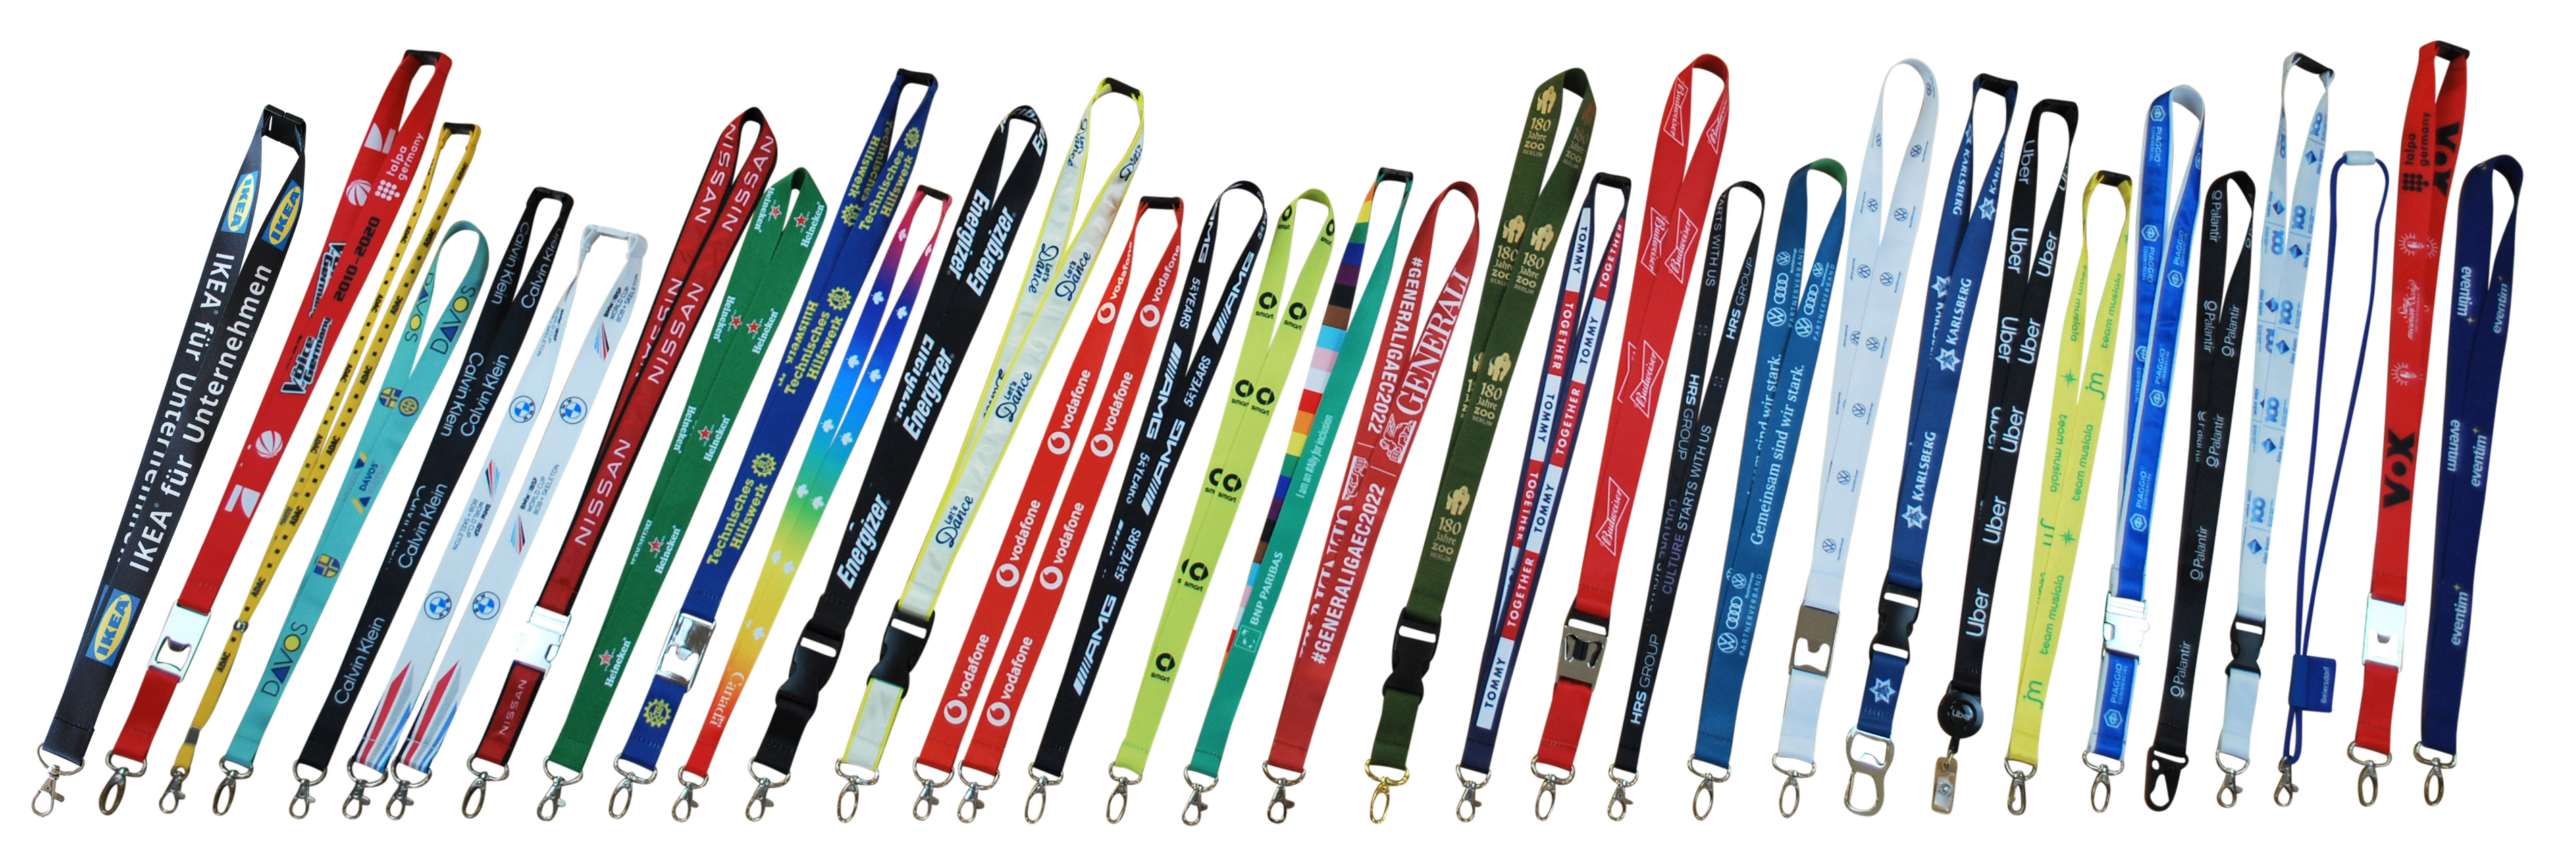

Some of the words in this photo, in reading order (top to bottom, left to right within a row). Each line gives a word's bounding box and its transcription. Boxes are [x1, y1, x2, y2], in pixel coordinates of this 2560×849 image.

[1530, 117, 1552, 132] 180
[2154, 126, 2163, 162] PIAGGIO
[2403, 133, 2416, 165] talpa
[2420, 112, 2432, 166] germany
[387, 145, 407, 176] talpa
[398, 132, 424, 181] germany
[1953, 148, 1970, 215] KARLSBERG
[2018, 140, 2035, 184] Uber
[229, 178, 252, 229] IKEA
[722, 136, 773, 232] NISSAN
[859, 150, 904, 230] Technisches
[880, 155, 913, 217] Hilfswerk
[271, 190, 300, 241] IKEA
[801, 202, 825, 248] Heineken
[949, 189, 990, 280] Energizer
[2209, 202, 2221, 242] Palantir
[333, 216, 380, 302] 2010-2020
[966, 207, 1015, 296] Energizer
[1110, 241, 1133, 299] vodafone
[1522, 252, 1545, 270] 180
[1572, 225, 1588, 274] TOMMY
[1599, 223, 1623, 289] TOGETHER
[1670, 219, 1691, 274] Budweiser
[1709, 234, 1721, 266] WITH
[2008, 227, 2029, 274] Uber
[2035, 231, 2058, 278] Uber
[2146, 247, 2155, 283] PIAGGIO
[200, 253, 235, 308] IKEA
[1055, 251, 1091, 301] Dance
[1152, 245, 1180, 302] vodafone
[1705, 270, 1717, 287] US
[1726, 308, 1741, 340] HRS
[1735, 257, 1753, 306] GROUP
[2458, 266, 2473, 317] eventim
[1255, 310, 1275, 320] smart
[1284, 319, 1303, 331] smart
[1813, 264, 1835, 341] PARTNERVERBAND
[1945, 278, 1972, 345] KARLSBERG
[2224, 305, 2240, 346] Palantir
[2493, 283, 2507, 334] eventim
[186, 321, 215, 361] für
[304, 317, 332, 384] Germany
[648, 282, 703, 384] NISSAN
[752, 308, 778, 354] Heineken
[784, 311, 830, 395] Technisches
[807, 316, 843, 380] Hilfswerk
[1368, 256, 1423, 435] #GENERALIGAEC2022
[1396, 267, 1470, 416] GENERALI
[1553, 303, 1573, 370] TOGETHER
[1579, 317, 1598, 365] TOMMY
[1998, 316, 2019, 363] Uber
[2203, 313, 2217, 353] Palantir
[161, 455, 192, 497] für
[182, 265, 272, 443] Unternehmen
[456, 352, 484, 399] Calvin
[1004, 381, 1017, 400] Let's
[1480, 381, 1503, 401] 180
[1636, 351, 1657, 409] Budweiser
[1685, 373, 1700, 405] HRS
[1767, 354, 1781, 391] stark.
[1787, 365, 1804, 402] stark.
[2155, 348, 2166, 385] PIAGGIO
[441, 400, 465, 437] Klein
[460, 390, 493, 437] Calvin
[482, 354, 509, 391] Klein
[902, 347, 953, 441] Energizer
[995, 371, 1032, 423] Dance
[1061, 369, 1091, 430] vodafone
[1104, 371, 1133, 432] vodafone
[1251, 403, 1270, 416] smart
[1538, 393, 1555, 442] TOMMY
[1761, 394, 1774, 418] wir
[1781, 404, 1794, 427] wir
[704, 414, 730, 462] Heineken
[1556, 387, 1581, 455] TOGETHER
[1678, 408, 1694, 460] GROUP
[1771, 430, 1788, 460] sind
[2057, 414, 2068, 444] team
[2209, 414, 2224, 455] Palantir
[2447, 419, 2460, 472] eventim
[359, 460, 379, 491] DAVOS
[1912, 431, 1936, 502] KARLSBERG
[2050, 448, 2062, 492] musiala
[2071, 470, 2085, 501] team
[2079, 424, 2093, 468] musiala
[2383, 428, 2415, 508] VOX
[2471, 435, 2487, 487] eventim
[575, 439, 631, 546] NISSAN
[730, 482, 768, 550] Hilfswerk
[944, 505, 958, 525] Let's
[1517, 473, 1538, 541] TOGETHER
[1534, 483, 1555, 533] TOMMY
[1600, 488, 1623, 547] Budweiser
[1662, 533, 1685, 594] CULTURE
[1677, 480, 1697, 531] STARTS
[1690, 444, 1706, 478] WITH
[1700, 425, 1711, 442] US
[1751, 462, 1780, 545] Gemeinsam
[398, 520, 430, 569] Calvin
[420, 483, 448, 520] Klein
[707, 478, 755, 565] Technisches
[837, 493, 889, 590] Energizer
[935, 495, 973, 548] Dance
[1438, 516, 1462, 535] 180
[654, 525, 681, 574] Heineken
[1311, 483, 1385, 665] #GENERALIGAEC2022
[1250, 601, 1263, 626] BNP
[1258, 550, 1283, 600] PARIBAS
[2044, 575, 2064, 622] musiala
[96, 600, 130, 656] IKEA
[1739, 573, 1763, 656] PARTNERVERBAND
[2039, 624, 2051, 655] team
[334, 654, 367, 704] Calvin
[357, 617, 385, 654] Klein
[1630, 690, 1647, 724] HRS
[1639, 634, 1658, 688] GROUP
[499, 679, 528, 755] NISSAN
